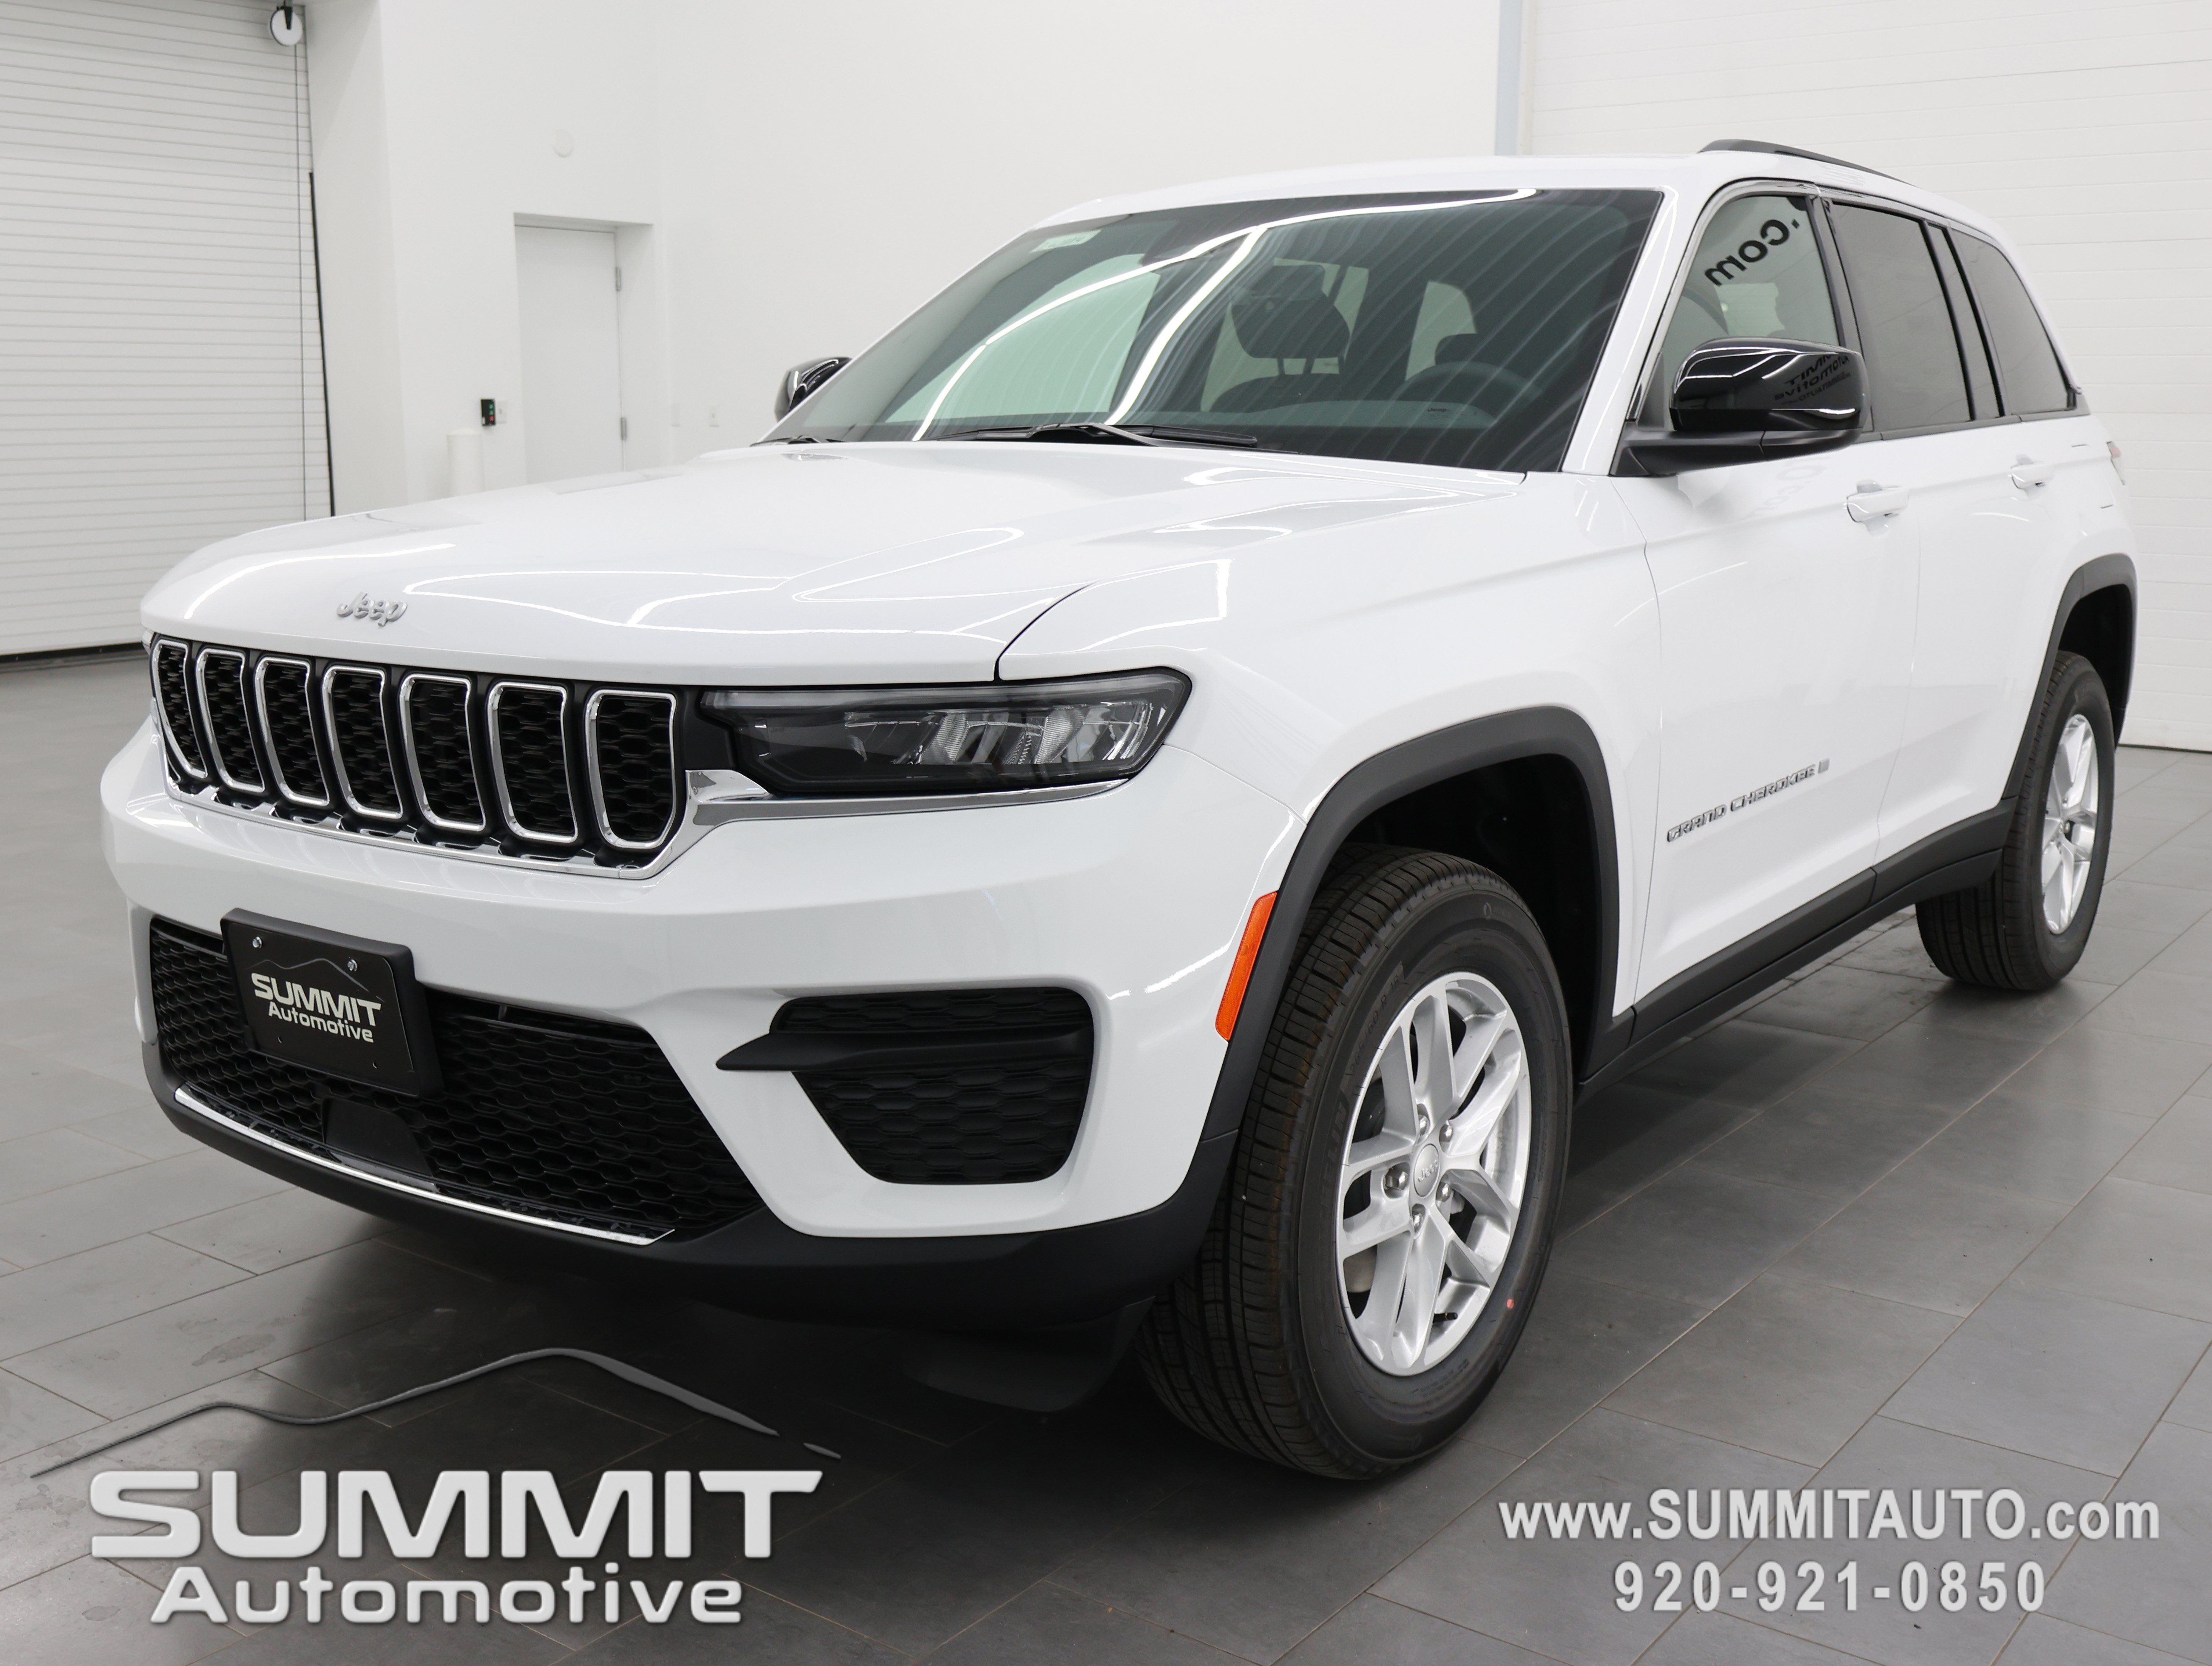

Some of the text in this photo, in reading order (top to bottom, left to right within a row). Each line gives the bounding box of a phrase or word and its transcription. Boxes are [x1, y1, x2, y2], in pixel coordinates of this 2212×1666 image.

[337, 591, 408, 627] Jeep
[1667, 764, 1816, 842] GRAND CHEROKEE
[251, 972, 381, 1027] SUMMIT
[268, 1001, 374, 1043] Automotive
